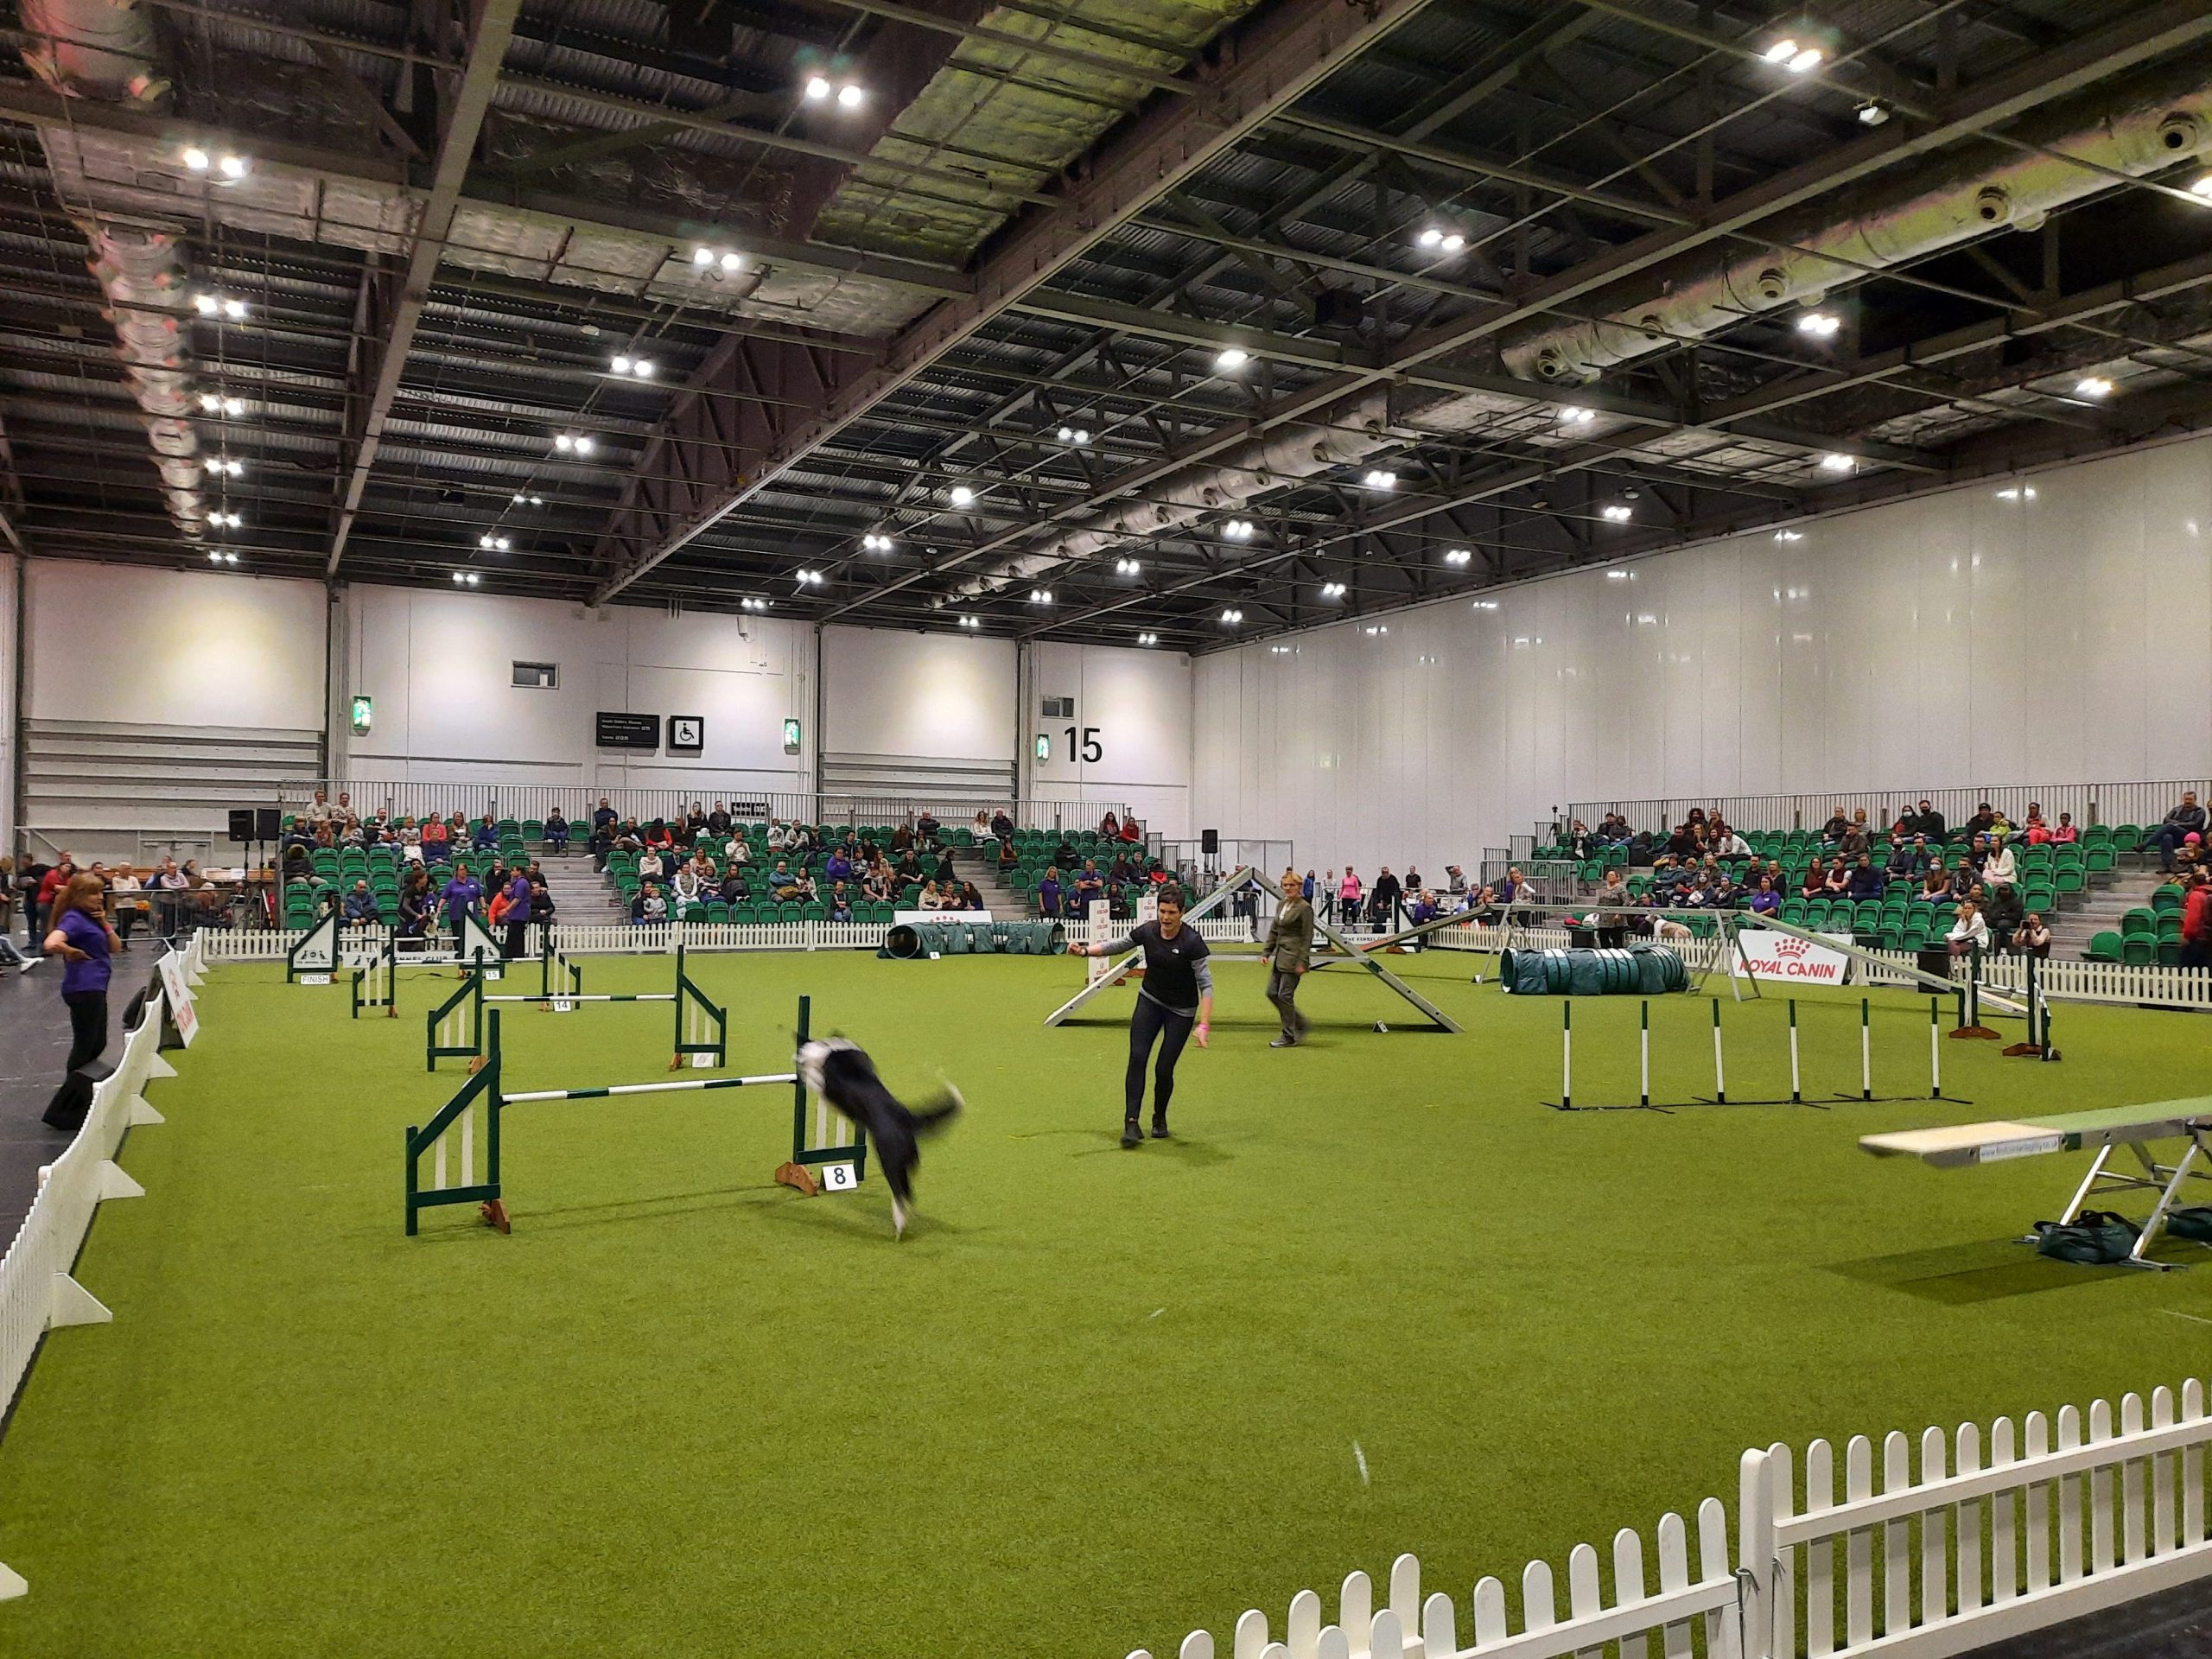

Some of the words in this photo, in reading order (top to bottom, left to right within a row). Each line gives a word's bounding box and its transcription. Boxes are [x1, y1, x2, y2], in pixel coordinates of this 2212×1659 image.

[1065, 727, 1103, 763] 15
[1787, 962, 1836, 978] CANIN
[834, 1166, 846, 1185] 8
